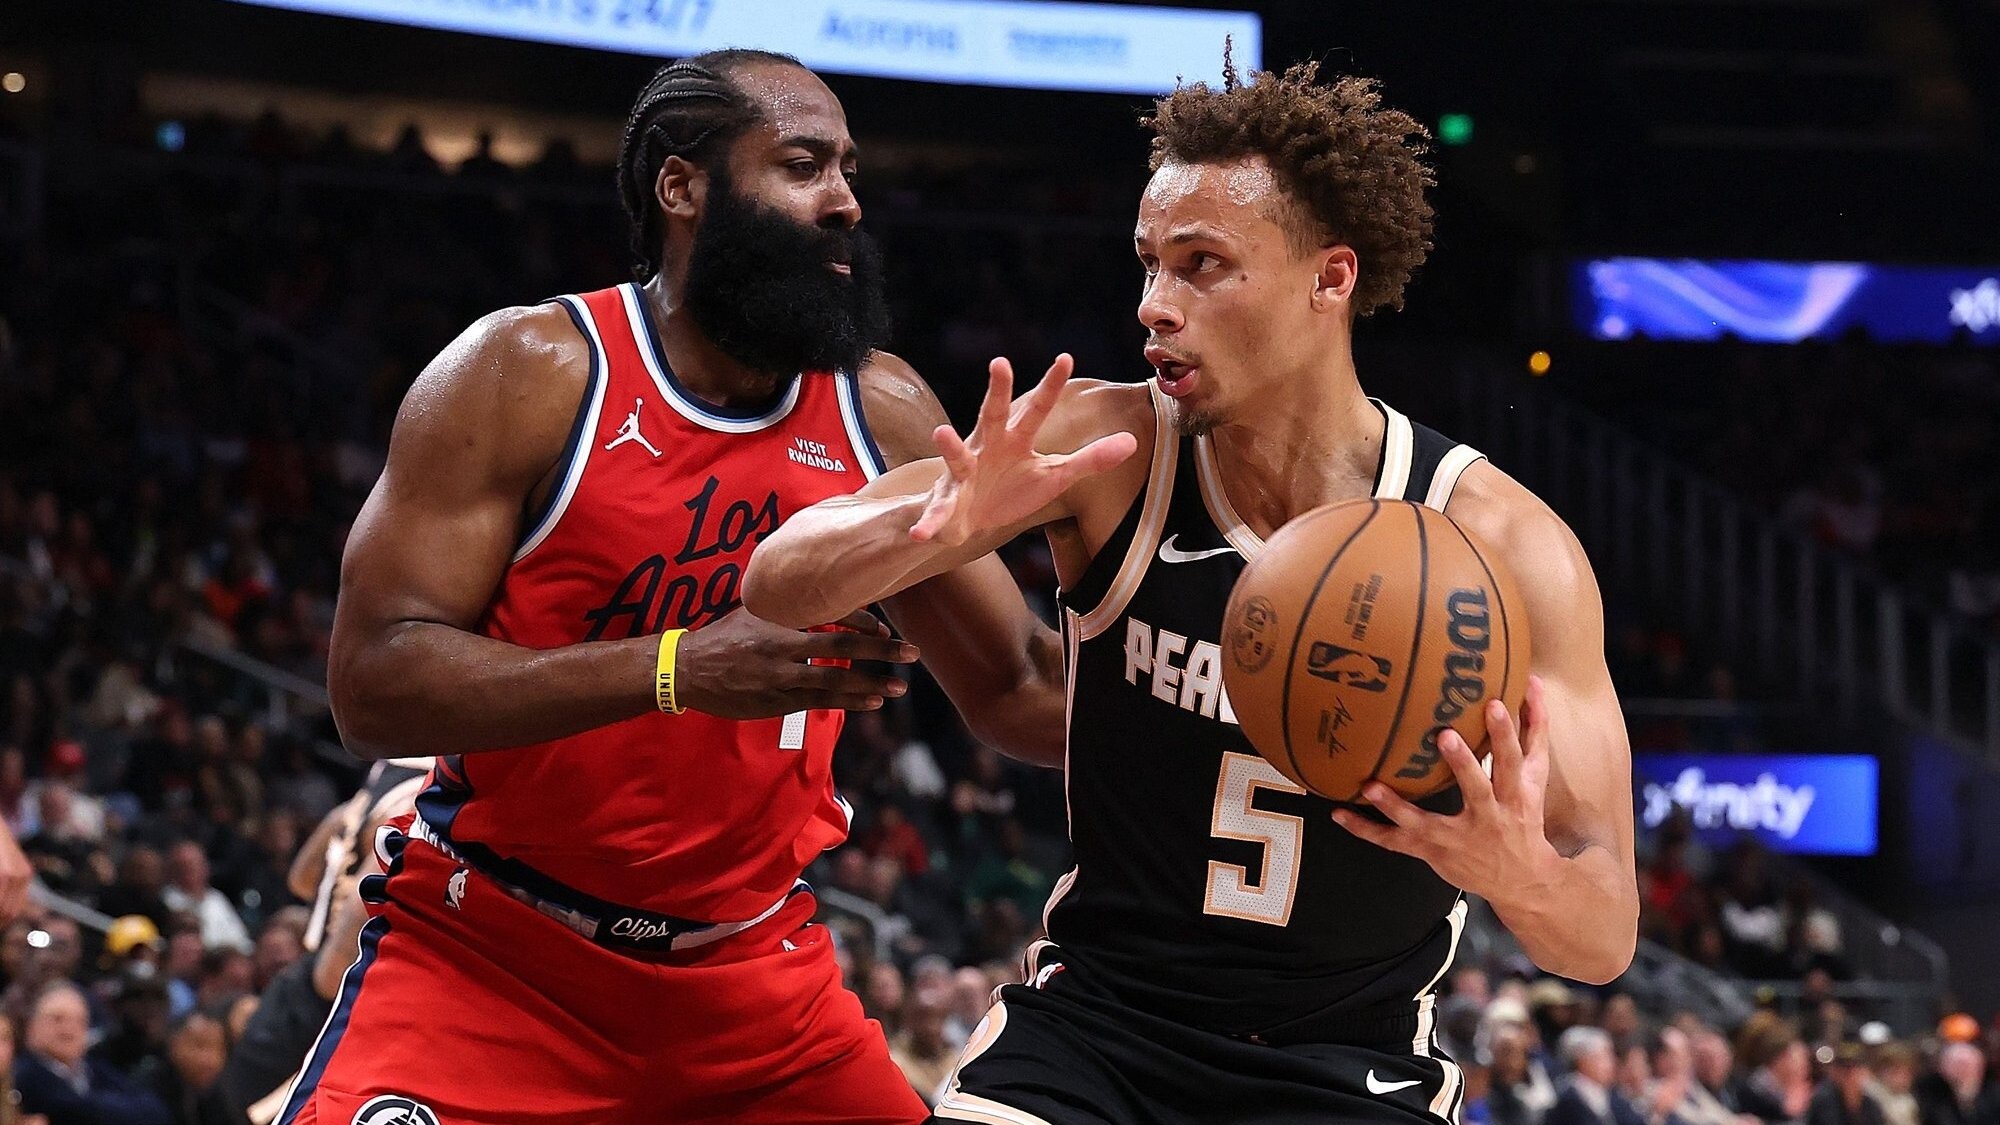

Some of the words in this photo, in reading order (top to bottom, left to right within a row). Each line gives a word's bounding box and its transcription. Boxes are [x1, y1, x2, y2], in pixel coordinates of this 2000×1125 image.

[787, 447, 847, 472] RWANDA
[794, 436, 827, 457] VISIT
[673, 475, 780, 565] Los
[1124, 616, 1240, 725] PEA
[1394, 585, 1491, 779] Wilson
[1203, 751, 1307, 927] 5
[610, 917, 670, 941] Clips
